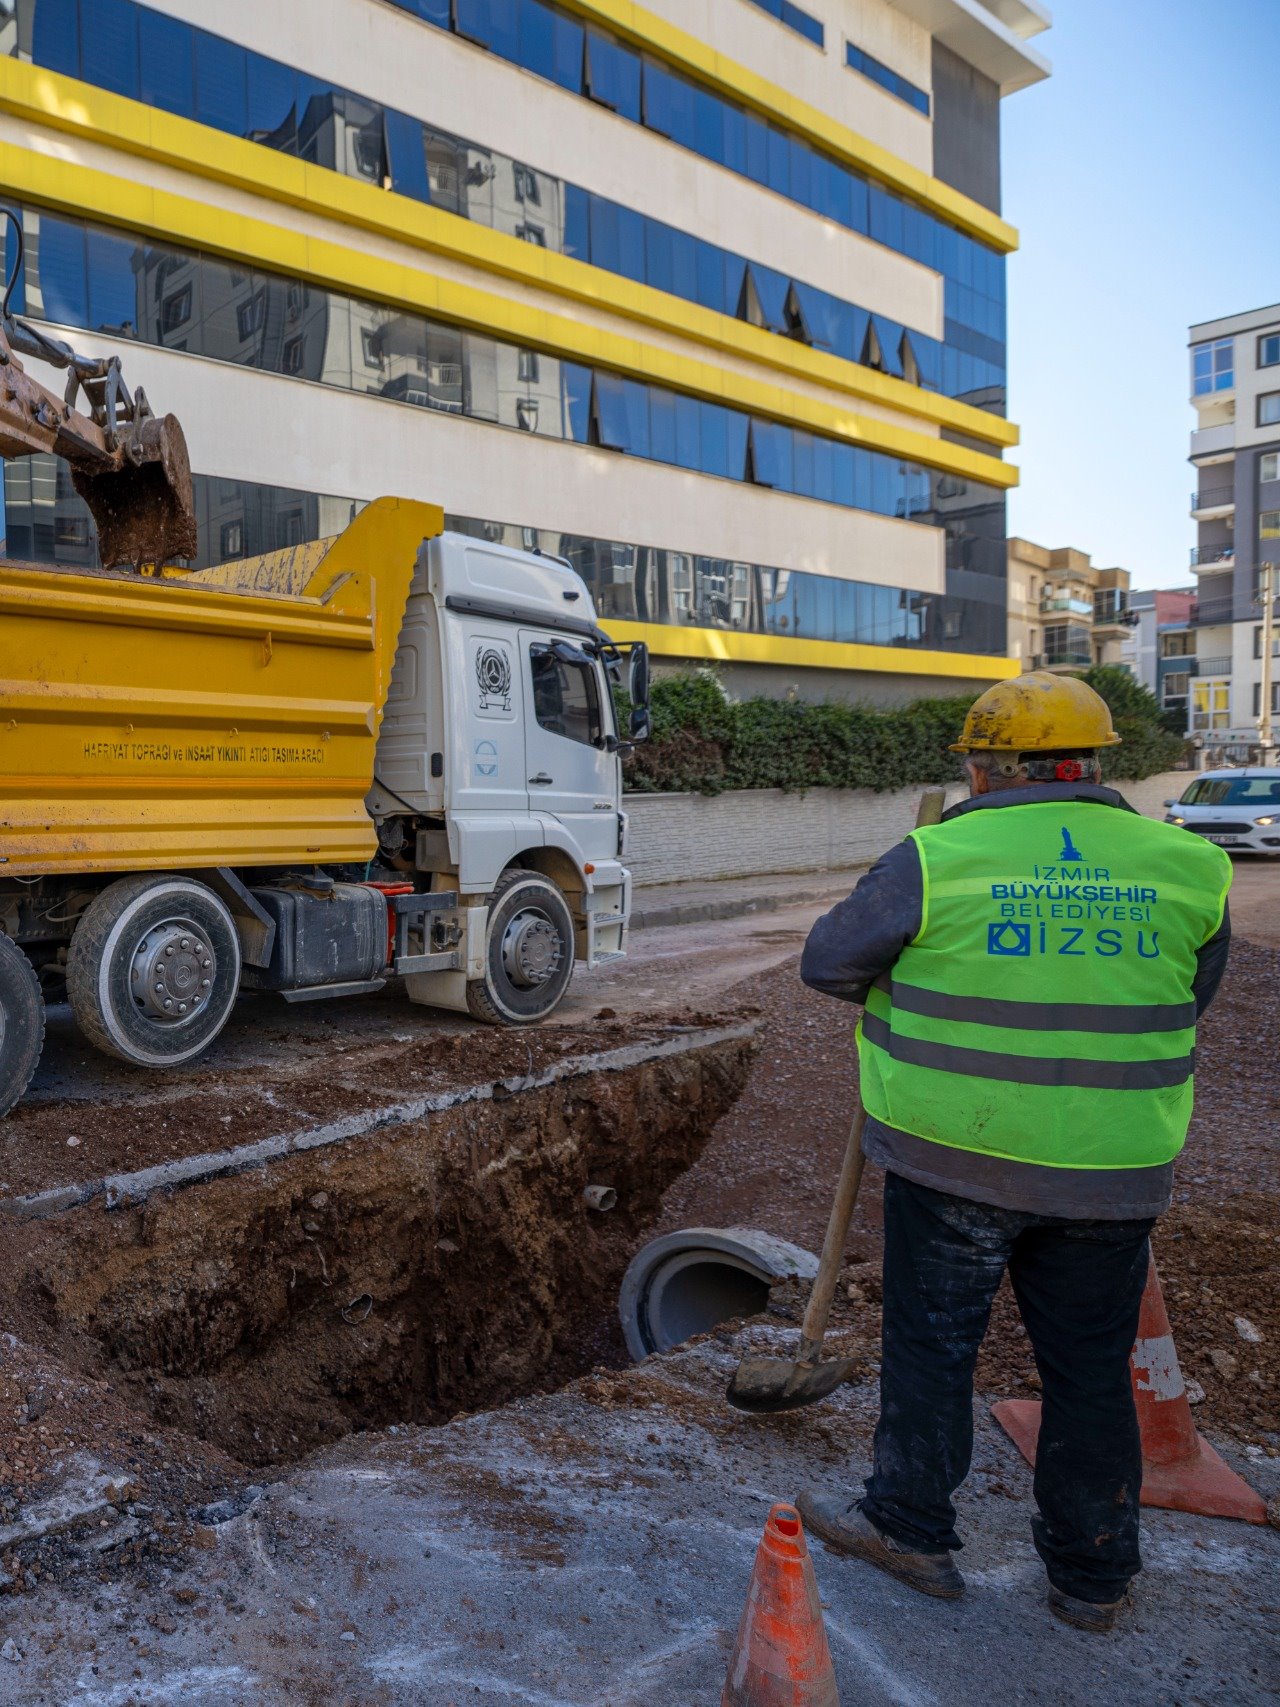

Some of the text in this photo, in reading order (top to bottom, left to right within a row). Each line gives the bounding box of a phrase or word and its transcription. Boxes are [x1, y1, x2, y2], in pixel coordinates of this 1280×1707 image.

[991, 881, 1158, 904] BÜYÜKŞEHİR
[1001, 902, 1151, 922] BELEDİYESİ
[1039, 921, 1161, 959] İZSU
